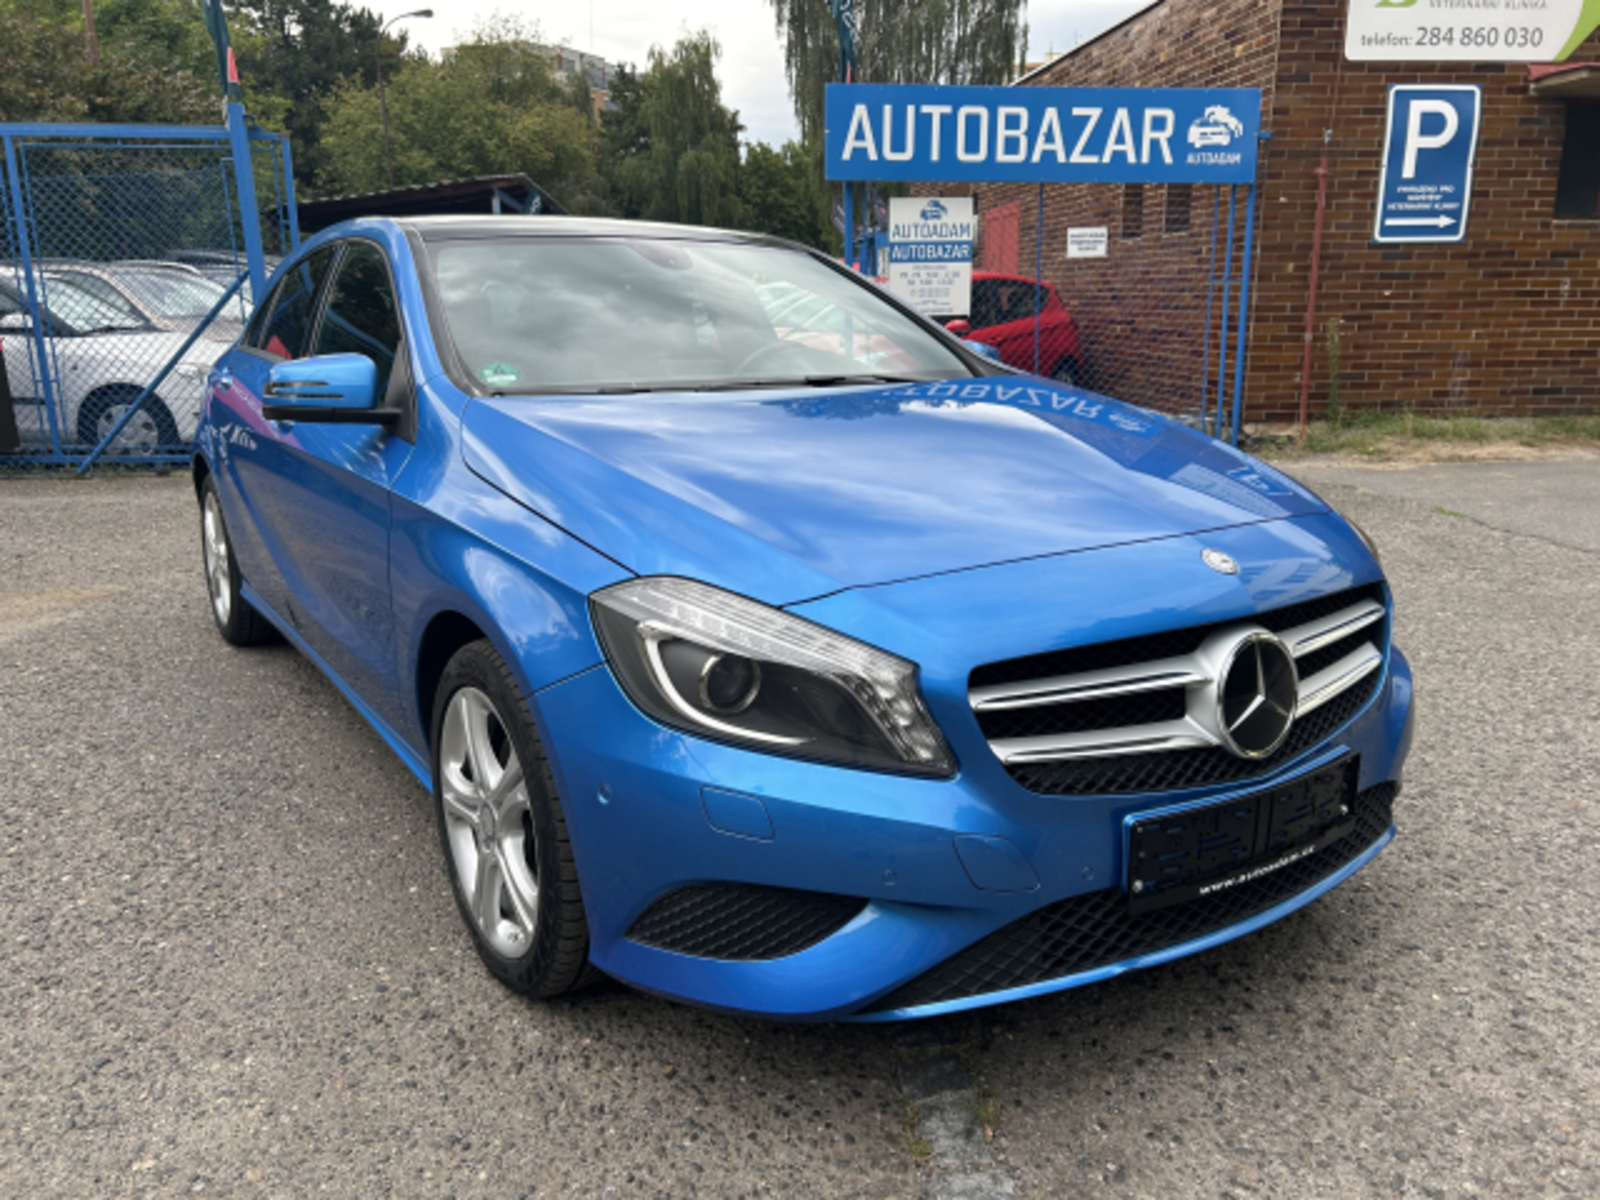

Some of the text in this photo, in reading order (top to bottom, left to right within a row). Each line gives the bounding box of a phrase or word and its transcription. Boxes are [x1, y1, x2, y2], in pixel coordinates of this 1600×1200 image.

[1360, 26, 1543, 48] telefon: 284 860 030
[841, 103, 1175, 165] AUTOBAZAR
[1401, 99, 1459, 179] P
[1186, 152, 1242, 165] AUTOADAM
[892, 222, 971, 238] AUTOADAM
[892, 244, 970, 260] AUTOBAZAR
